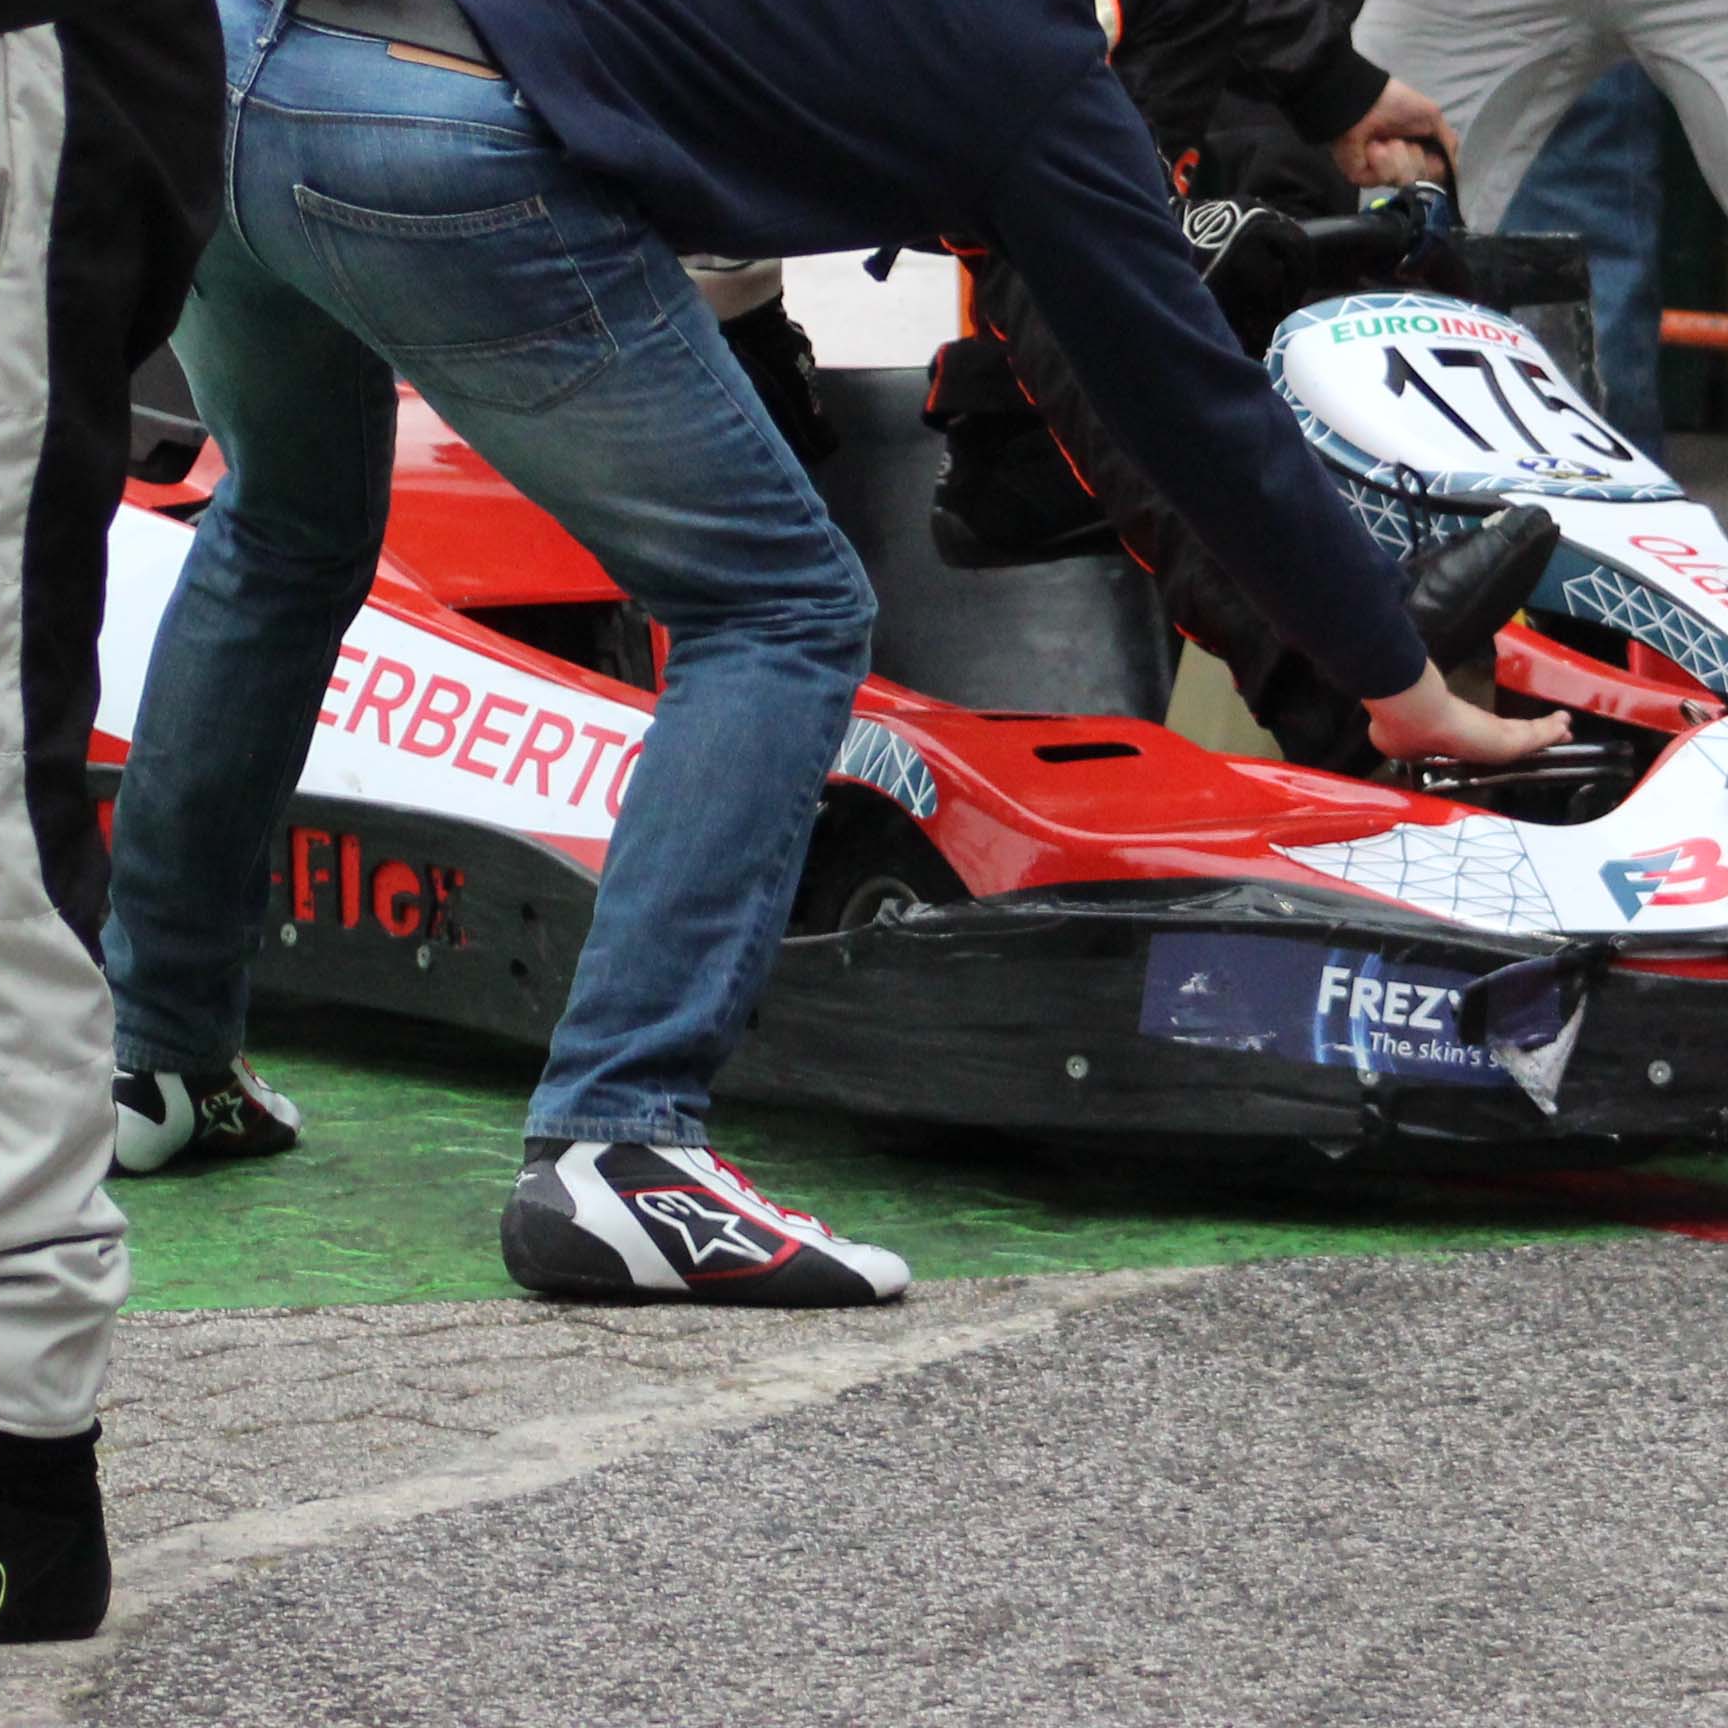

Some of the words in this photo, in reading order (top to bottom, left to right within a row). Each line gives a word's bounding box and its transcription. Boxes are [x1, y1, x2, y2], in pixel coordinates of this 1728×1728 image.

[1331, 315, 1521, 346] EUROINDY
[1383, 346, 1633, 462] 175
[318, 644, 643, 821] ERBERT
[1318, 966, 1462, 1031] FREZ
[1369, 1032, 1412, 1058] The
